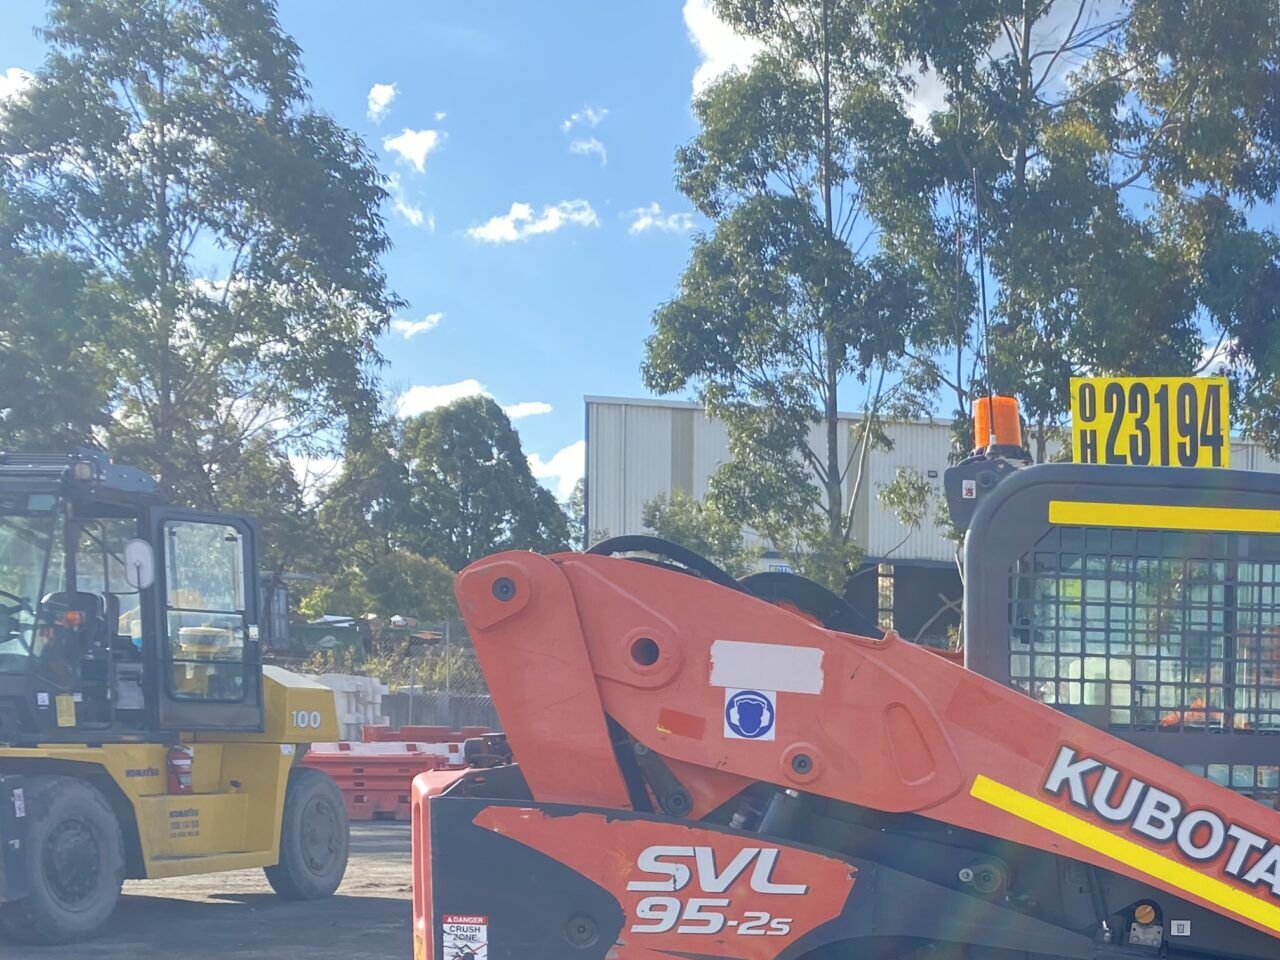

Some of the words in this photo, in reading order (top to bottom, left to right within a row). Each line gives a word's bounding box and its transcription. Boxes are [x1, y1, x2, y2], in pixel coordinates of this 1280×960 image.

[1104, 382, 1224, 468] 23194
[291, 710, 321, 728] 100
[626, 846, 808, 895] SVL
[453, 916, 484, 924] DANGER
[449, 925, 481, 934] CRUSH
[453, 934, 478, 942] ZONE
